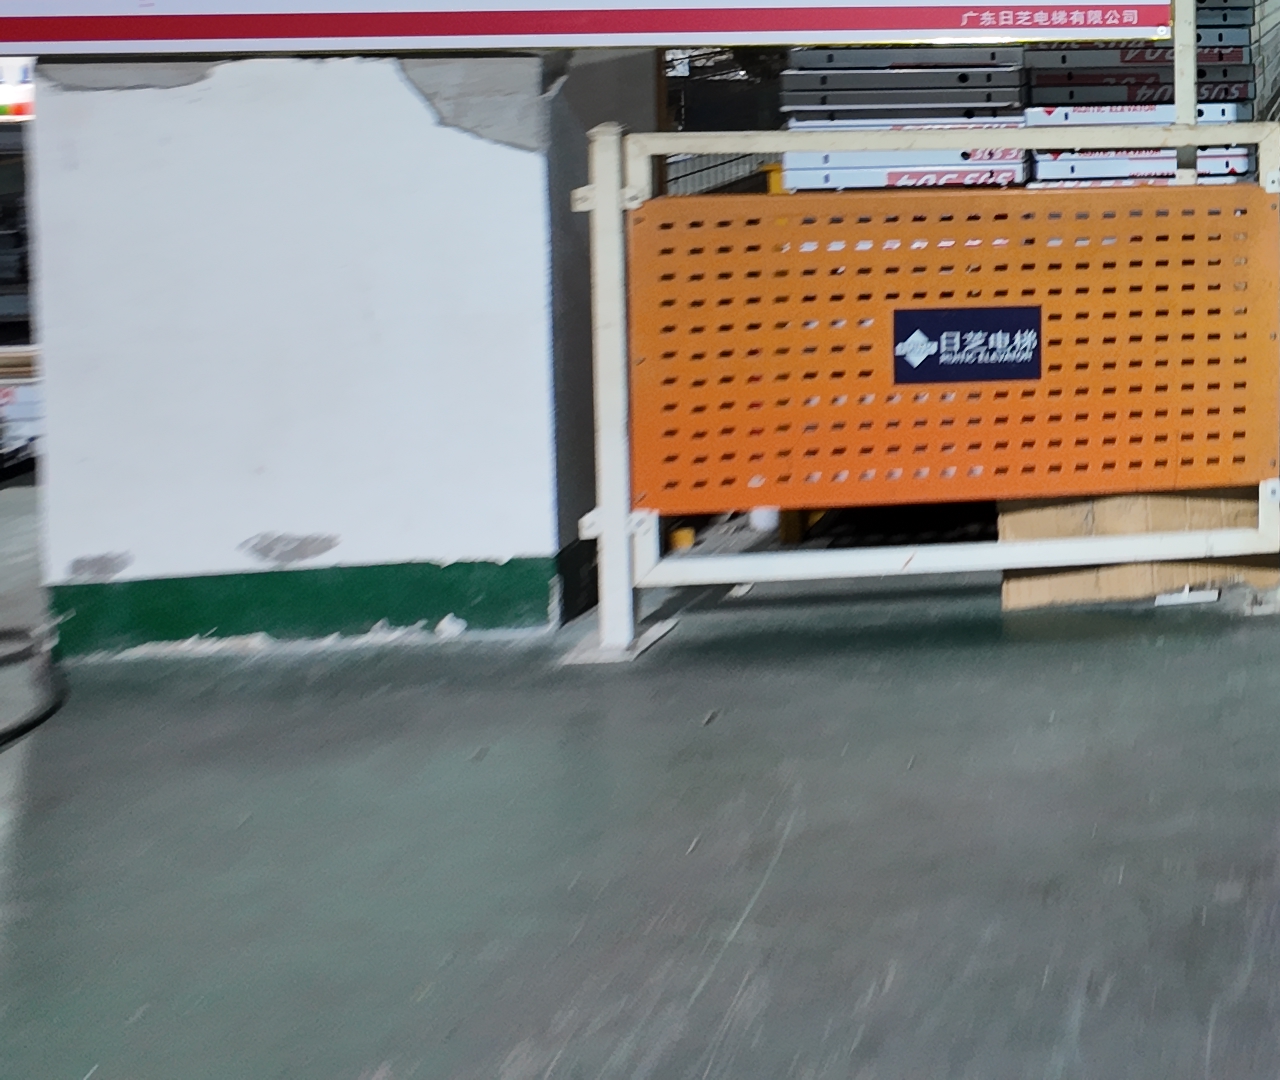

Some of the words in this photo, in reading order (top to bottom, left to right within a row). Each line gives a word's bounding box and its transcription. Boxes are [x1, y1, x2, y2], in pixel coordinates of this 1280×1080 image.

[960, 9, 1139, 27] 广东日芝电梯有限公司
